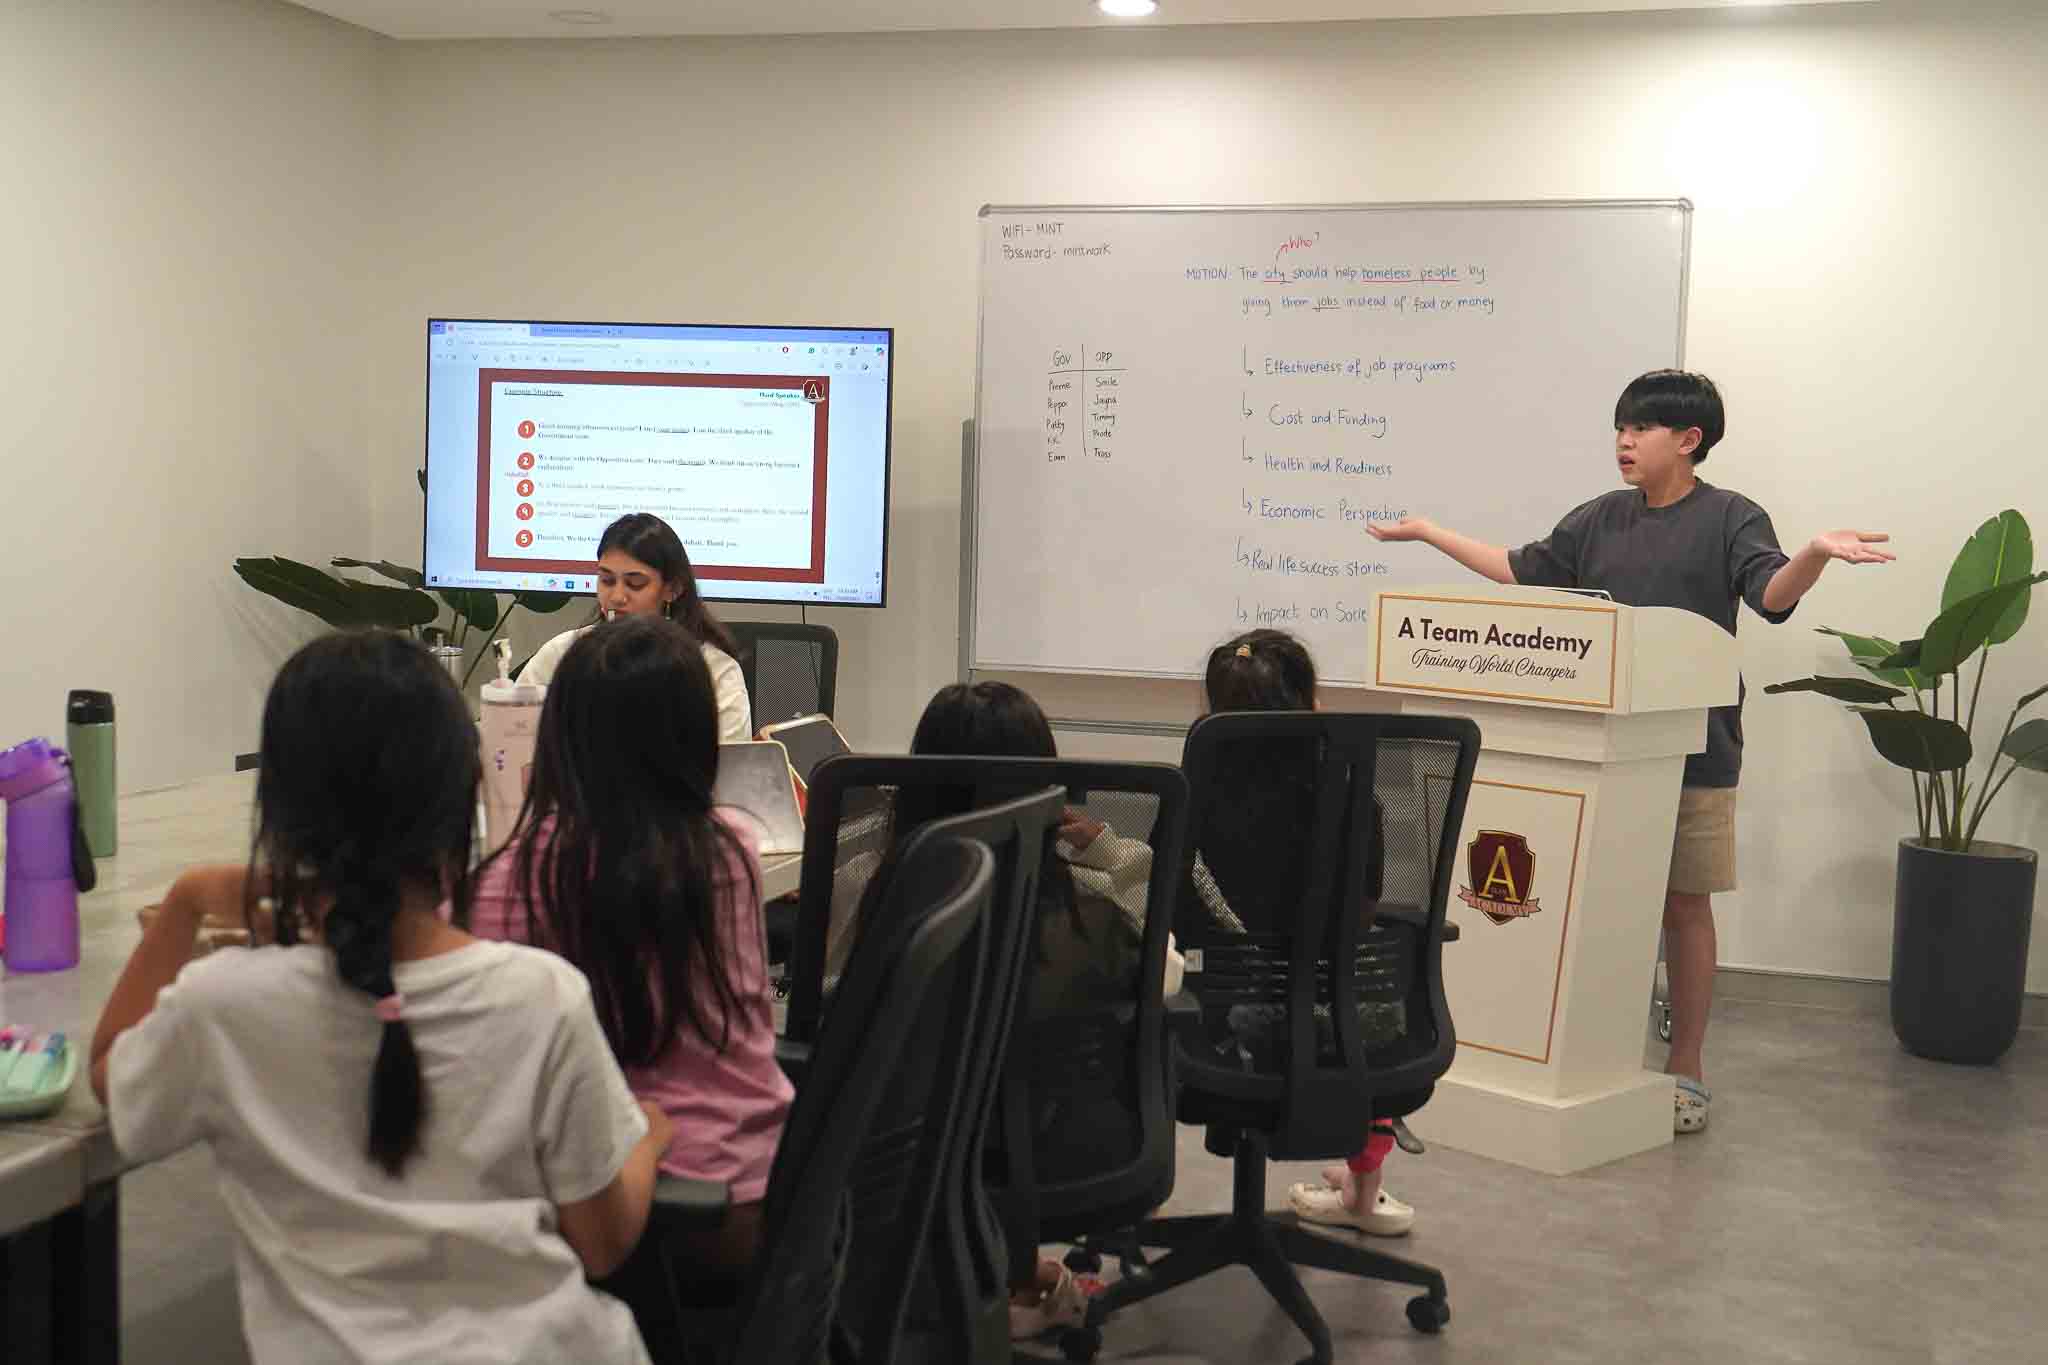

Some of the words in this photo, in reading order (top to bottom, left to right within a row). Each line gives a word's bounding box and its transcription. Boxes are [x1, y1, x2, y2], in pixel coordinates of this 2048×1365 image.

[1036, 222, 1065, 234] MINT
[1239, 266, 1257, 280] The
[1264, 266, 1285, 284] city
[1293, 266, 1328, 280] should
[1335, 266, 1357, 284] help
[1361, 266, 1411, 281] homeless
[1420, 266, 1457, 283] people
[1468, 265, 1487, 284] by
[1242, 297, 1272, 316] giving
[1281, 295, 1309, 307] them
[1316, 294, 1339, 312] jobs
[1346, 295, 1386, 307] instead
[1394, 294, 1407, 312] of
[1414, 294, 1436, 312] food
[1440, 298, 1453, 309] or
[1457, 297, 1495, 314] money
[1264, 357, 1343, 376] Effectiveness
[1347, 357, 1361, 377] of
[1364, 356, 1387, 378] job
[1393, 359, 1456, 382] programs
[1268, 403, 1304, 427] Cost
[1311, 410, 1331, 425] and
[1337, 408, 1387, 439] Funding
[1264, 452, 1305, 473] Health
[1309, 457, 1331, 473] and
[1335, 456, 1393, 478] Readiness
[1259, 498, 1326, 519] Economic
[1338, 498, 1408, 525] Perspective
[1251, 549, 1274, 571] Real
[1278, 553, 1298, 576] life
[1299, 560, 1340, 577] success
[1256, 603, 1299, 626] Impact
[1310, 608, 1328, 620] on
[1335, 601, 1368, 624] Socie
[1398, 616, 1415, 639] A
[1420, 618, 1479, 645] Team
[1484, 623, 1593, 660] Academy
[1411, 648, 1468, 673] Training
[1468, 654, 1514, 675] World
[1514, 657, 1578, 682] Changers
[1478, 845, 1521, 903] A
